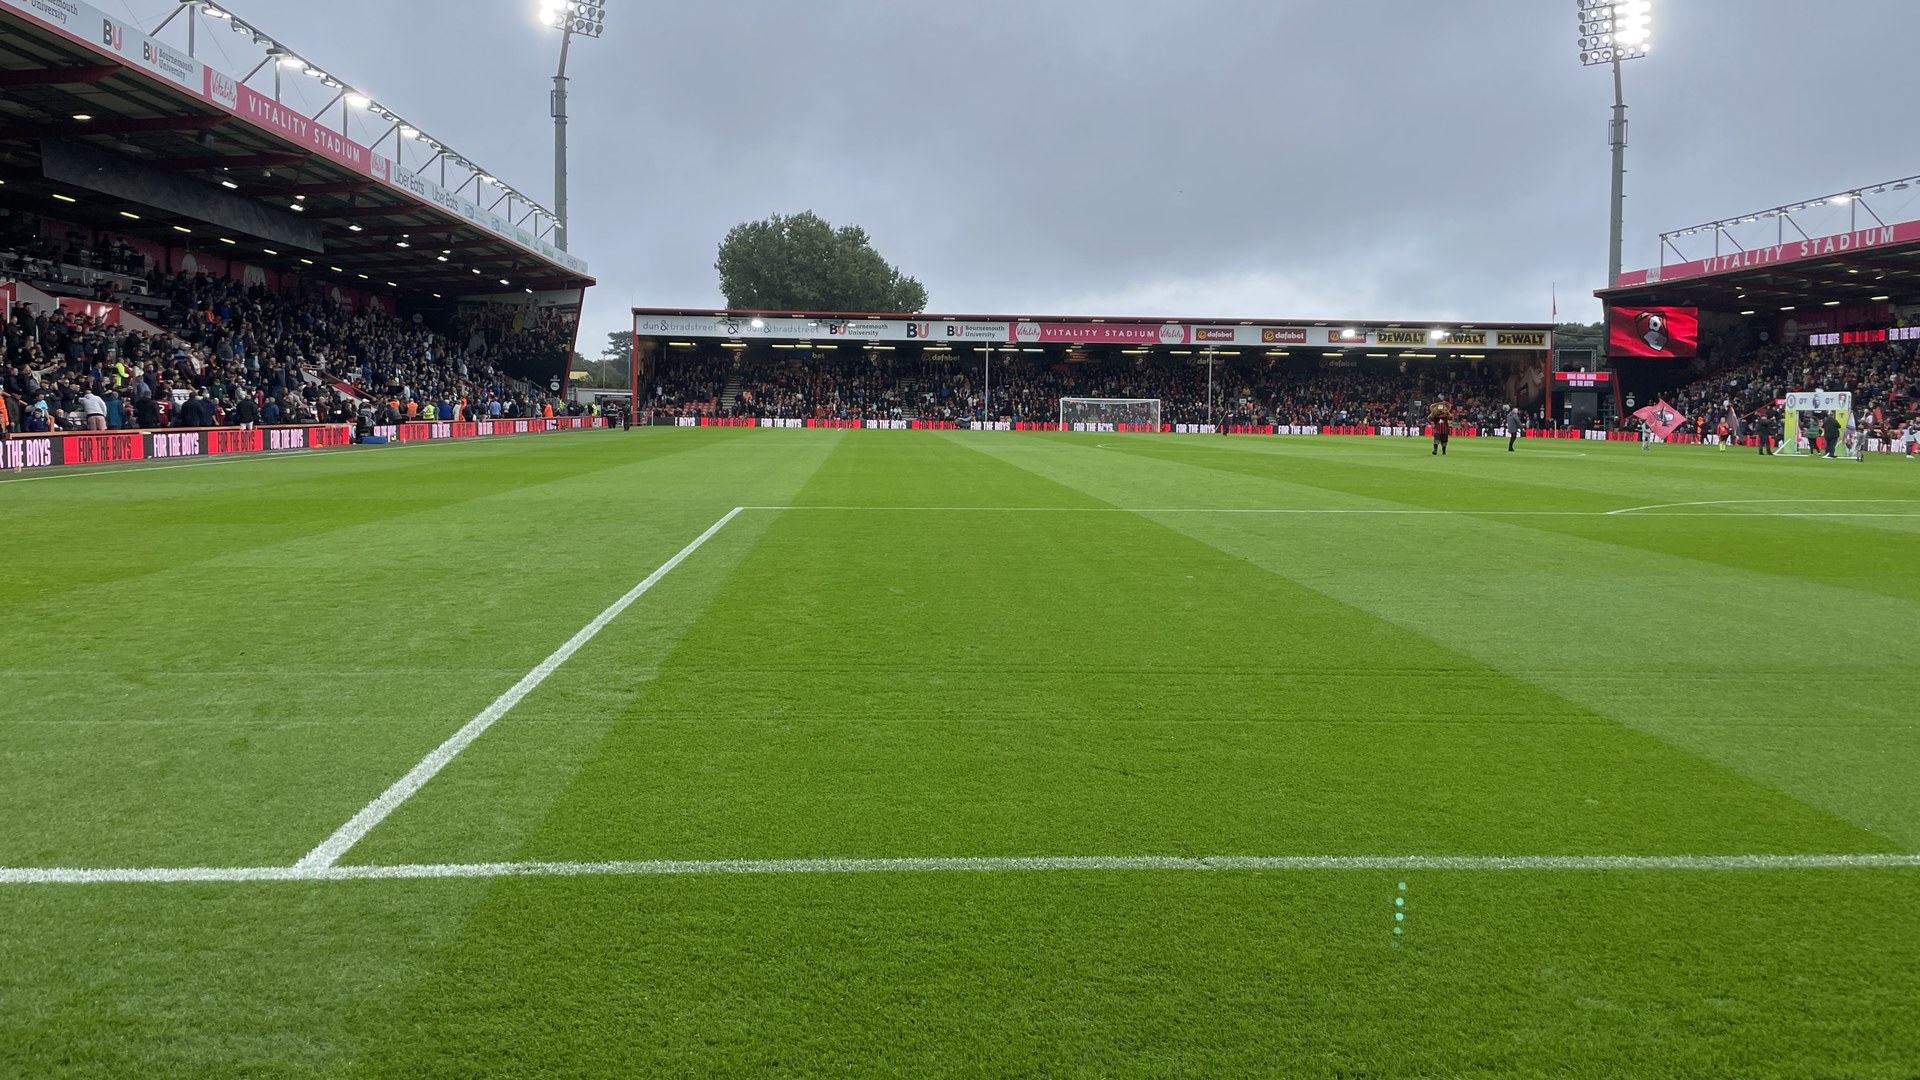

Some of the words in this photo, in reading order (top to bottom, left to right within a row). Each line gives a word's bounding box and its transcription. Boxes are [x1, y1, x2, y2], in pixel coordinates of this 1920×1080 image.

[103, 18, 122, 50] BU
[143, 41, 157, 65] BU
[159, 48, 194, 74] Bournemouth
[159, 59, 186, 81] University
[212, 72, 236, 102] Vitality
[248, 95, 307, 137] VITALITY
[314, 128, 360, 163] STADIUM
[394, 166, 409, 187] Uber
[410, 174, 425, 195] Eats
[432, 186, 446, 203] Uber
[1703, 245, 1784, 273] VITALITY
[1801, 226, 1895, 257] STADIUM
[906, 323, 930, 338] BU
[947, 325, 964, 337] BU
[1016, 326, 1041, 339] Vitality
[1046, 329, 1098, 337] VITALITY
[1160, 327, 1183, 338] Vitality
[1207, 330, 1233, 339] dafabet
[1275, 331, 1304, 340] dafabet
[679, 416, 696, 427] BOYS
[761, 418, 773, 428] FOR
[774, 418, 785, 428] THE
[785, 418, 802, 428] BOYS
[866, 420, 878, 429] FOR
[879, 420, 890, 429] THE
[890, 420, 907, 429] BOYS
[970, 421, 982, 431] FOR
[983, 421, 994, 431] THE
[994, 421, 1011, 431] BOYS
[1073, 422, 1085, 432] FOR
[1086, 422, 1097, 432] THE
[1175, 424, 1187, 433] FOR
[1188, 424, 1199, 433] THE
[1200, 424, 1216, 434] BOYS
[1278, 425, 1289, 435] FOR
[1291, 425, 1301, 435] THE
[1301, 426, 1318, 435] BOYS
[1380, 426, 1392, 436] FOR
[1392, 426, 1403, 436] THE
[153, 434, 167, 458] FOR
[168, 433, 181, 457] THE
[181, 432, 199, 455] BOYS
[217, 432, 228, 453] FOR
[229, 431, 239, 452] THE
[270, 429, 280, 450] FOR
[281, 429, 290, 449] THE
[290, 429, 304, 448] BOYS
[6, 439, 24, 468] THE
[26, 438, 51, 467] BOYS
[78, 437, 94, 462] FOR
[96, 436, 110, 461] THE
[112, 435, 132, 459] BOYS
